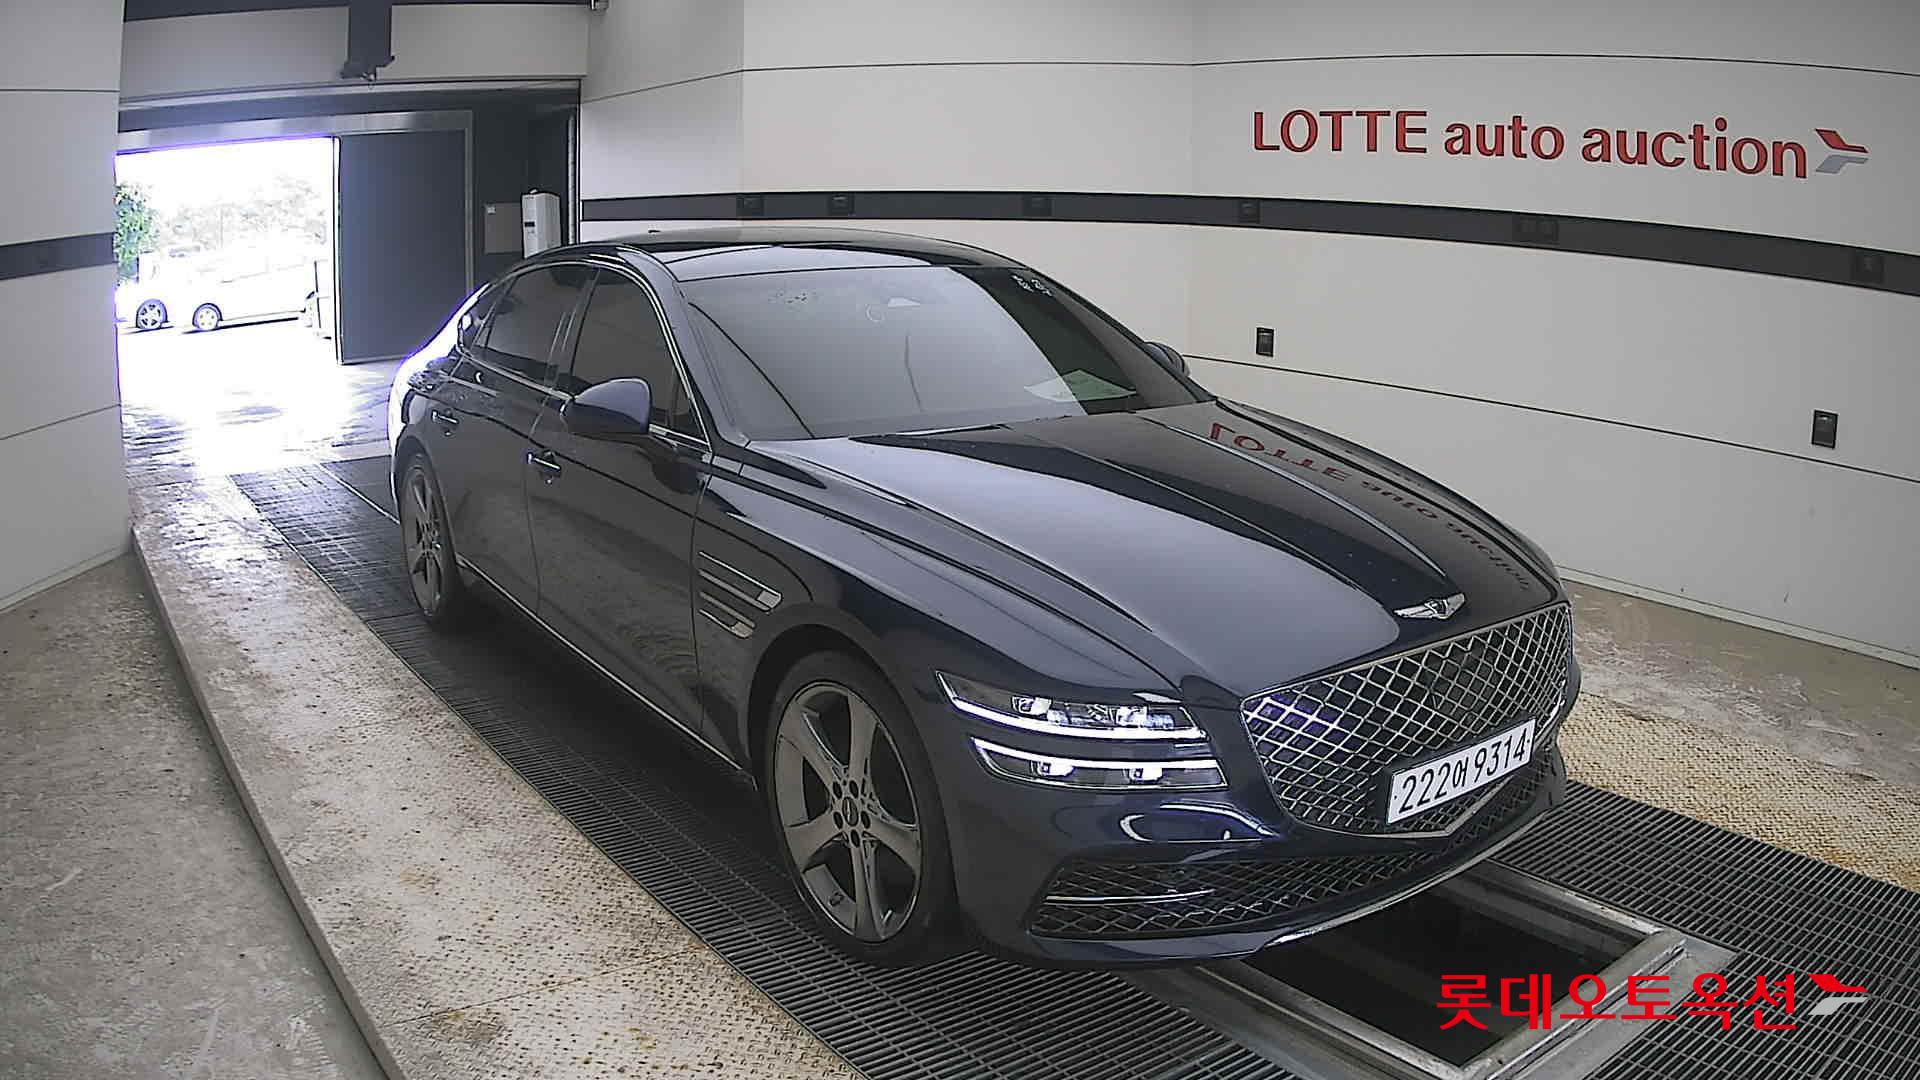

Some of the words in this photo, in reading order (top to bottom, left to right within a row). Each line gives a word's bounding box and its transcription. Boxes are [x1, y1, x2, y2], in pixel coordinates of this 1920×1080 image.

[1253, 110, 1428, 154] LOTTE
[1444, 115, 1565, 160] auto
[1581, 117, 1808, 180] auction
[1473, 727, 1528, 783] 9314
